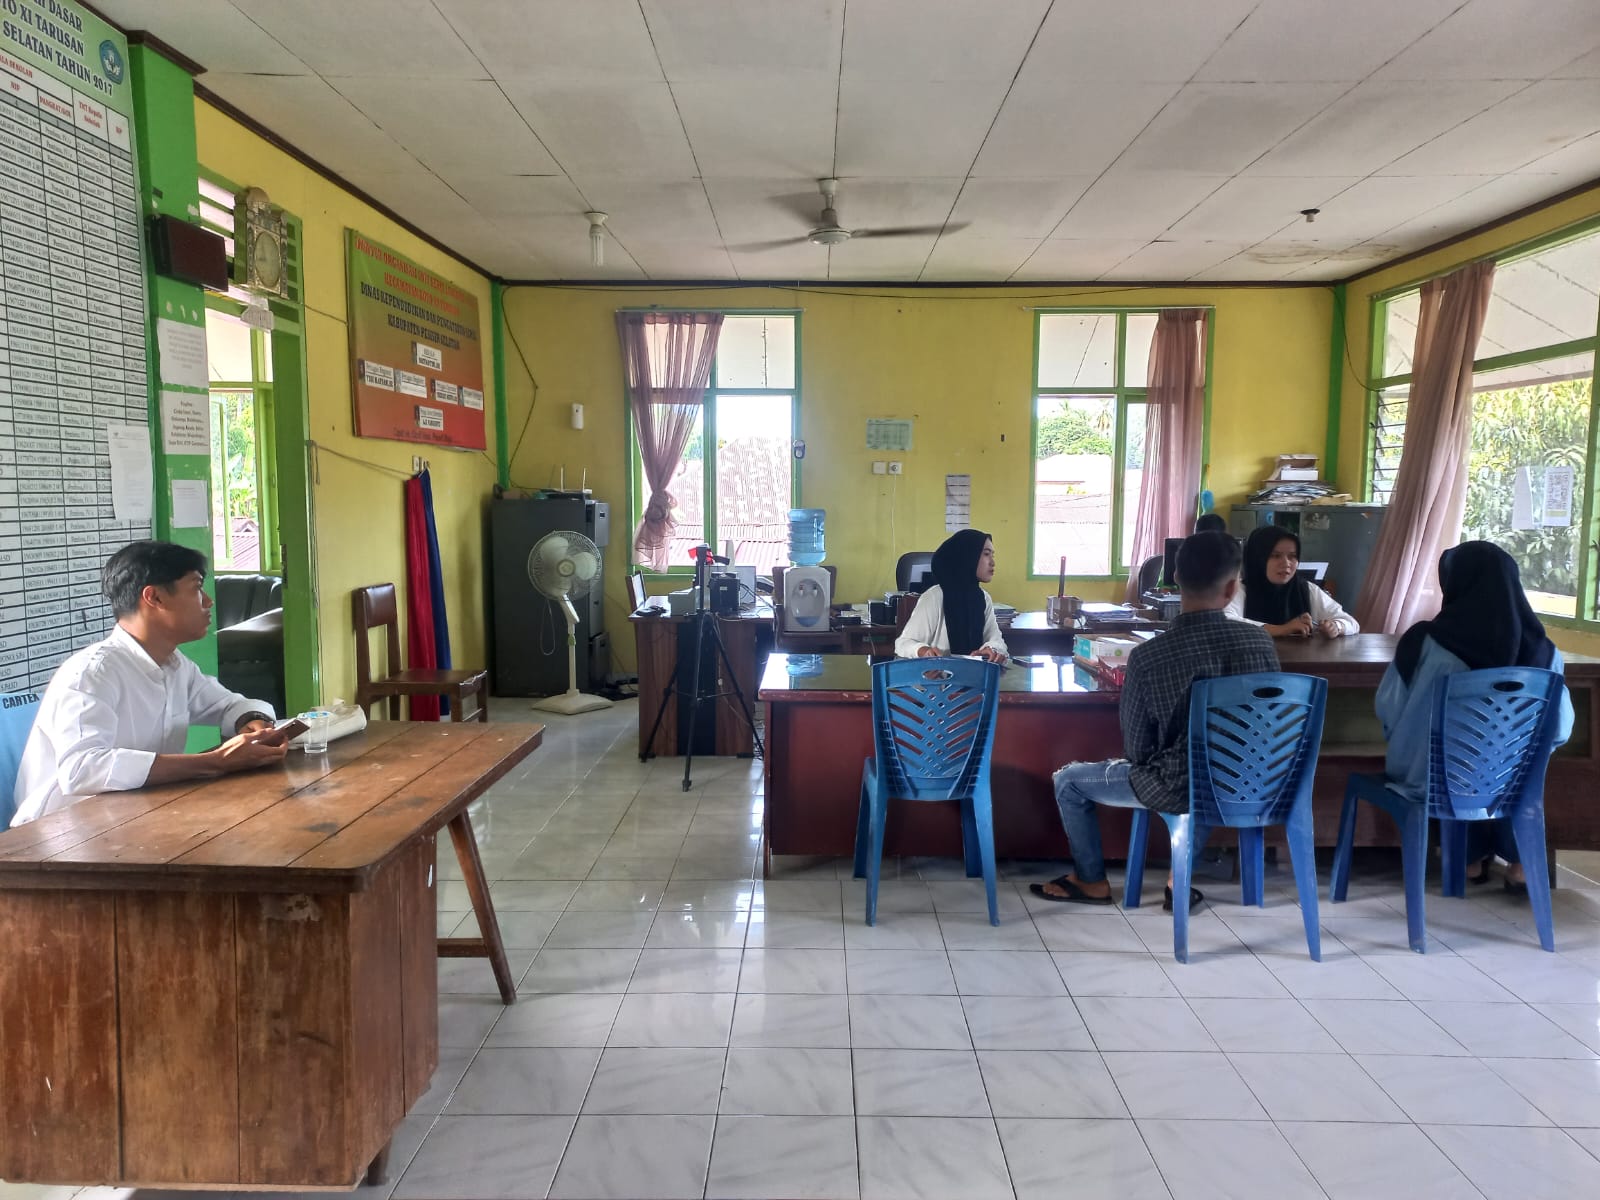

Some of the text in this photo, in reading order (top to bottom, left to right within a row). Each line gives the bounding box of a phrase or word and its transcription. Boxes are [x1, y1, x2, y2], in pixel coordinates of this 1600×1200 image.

[20, 4, 33, 26] XI
[34, 13, 84, 56] TARUSAN
[48, 0, 83, 32] DASAR
[3, 20, 113, 96] SELATAN TAHUN 2017
